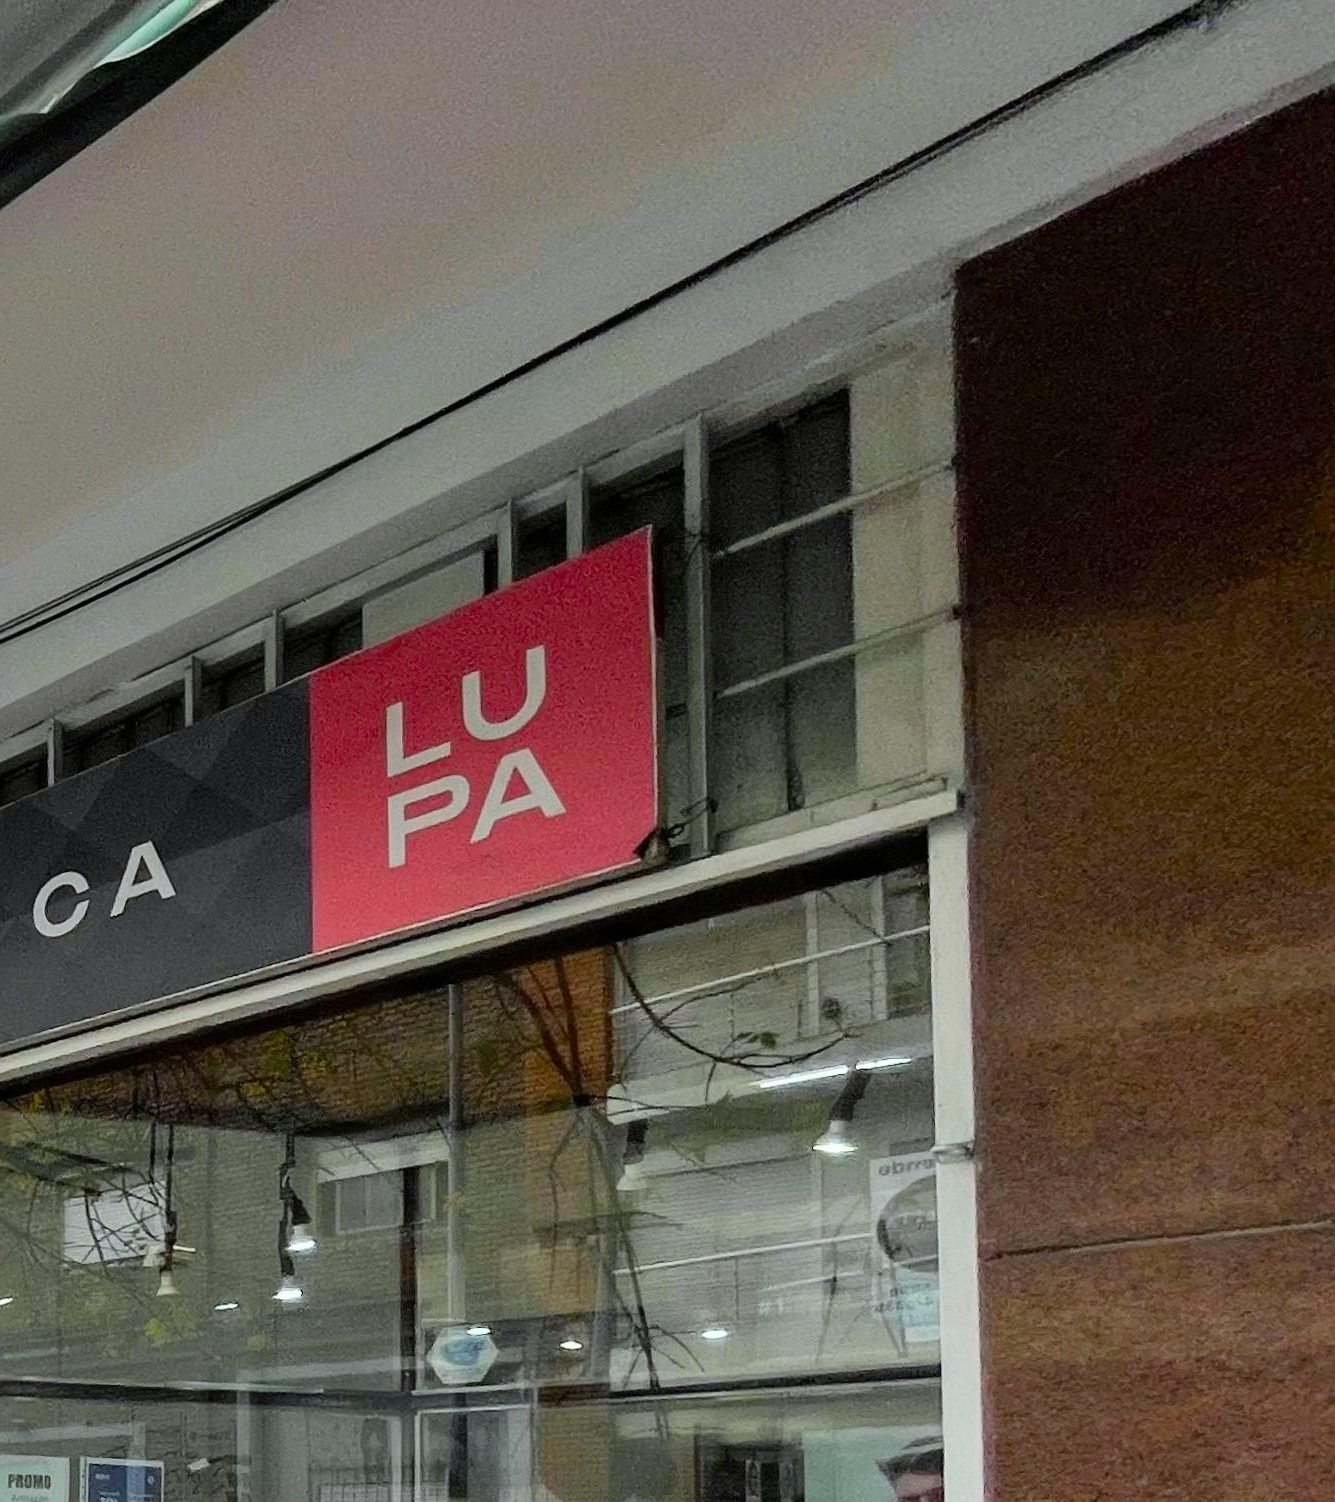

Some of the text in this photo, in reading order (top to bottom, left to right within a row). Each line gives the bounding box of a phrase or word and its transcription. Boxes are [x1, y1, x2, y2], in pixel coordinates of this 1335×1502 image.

[386, 646, 546, 777] LU
[387, 748, 566, 868] PA
[8, 1473, 51, 1490] PROMO
